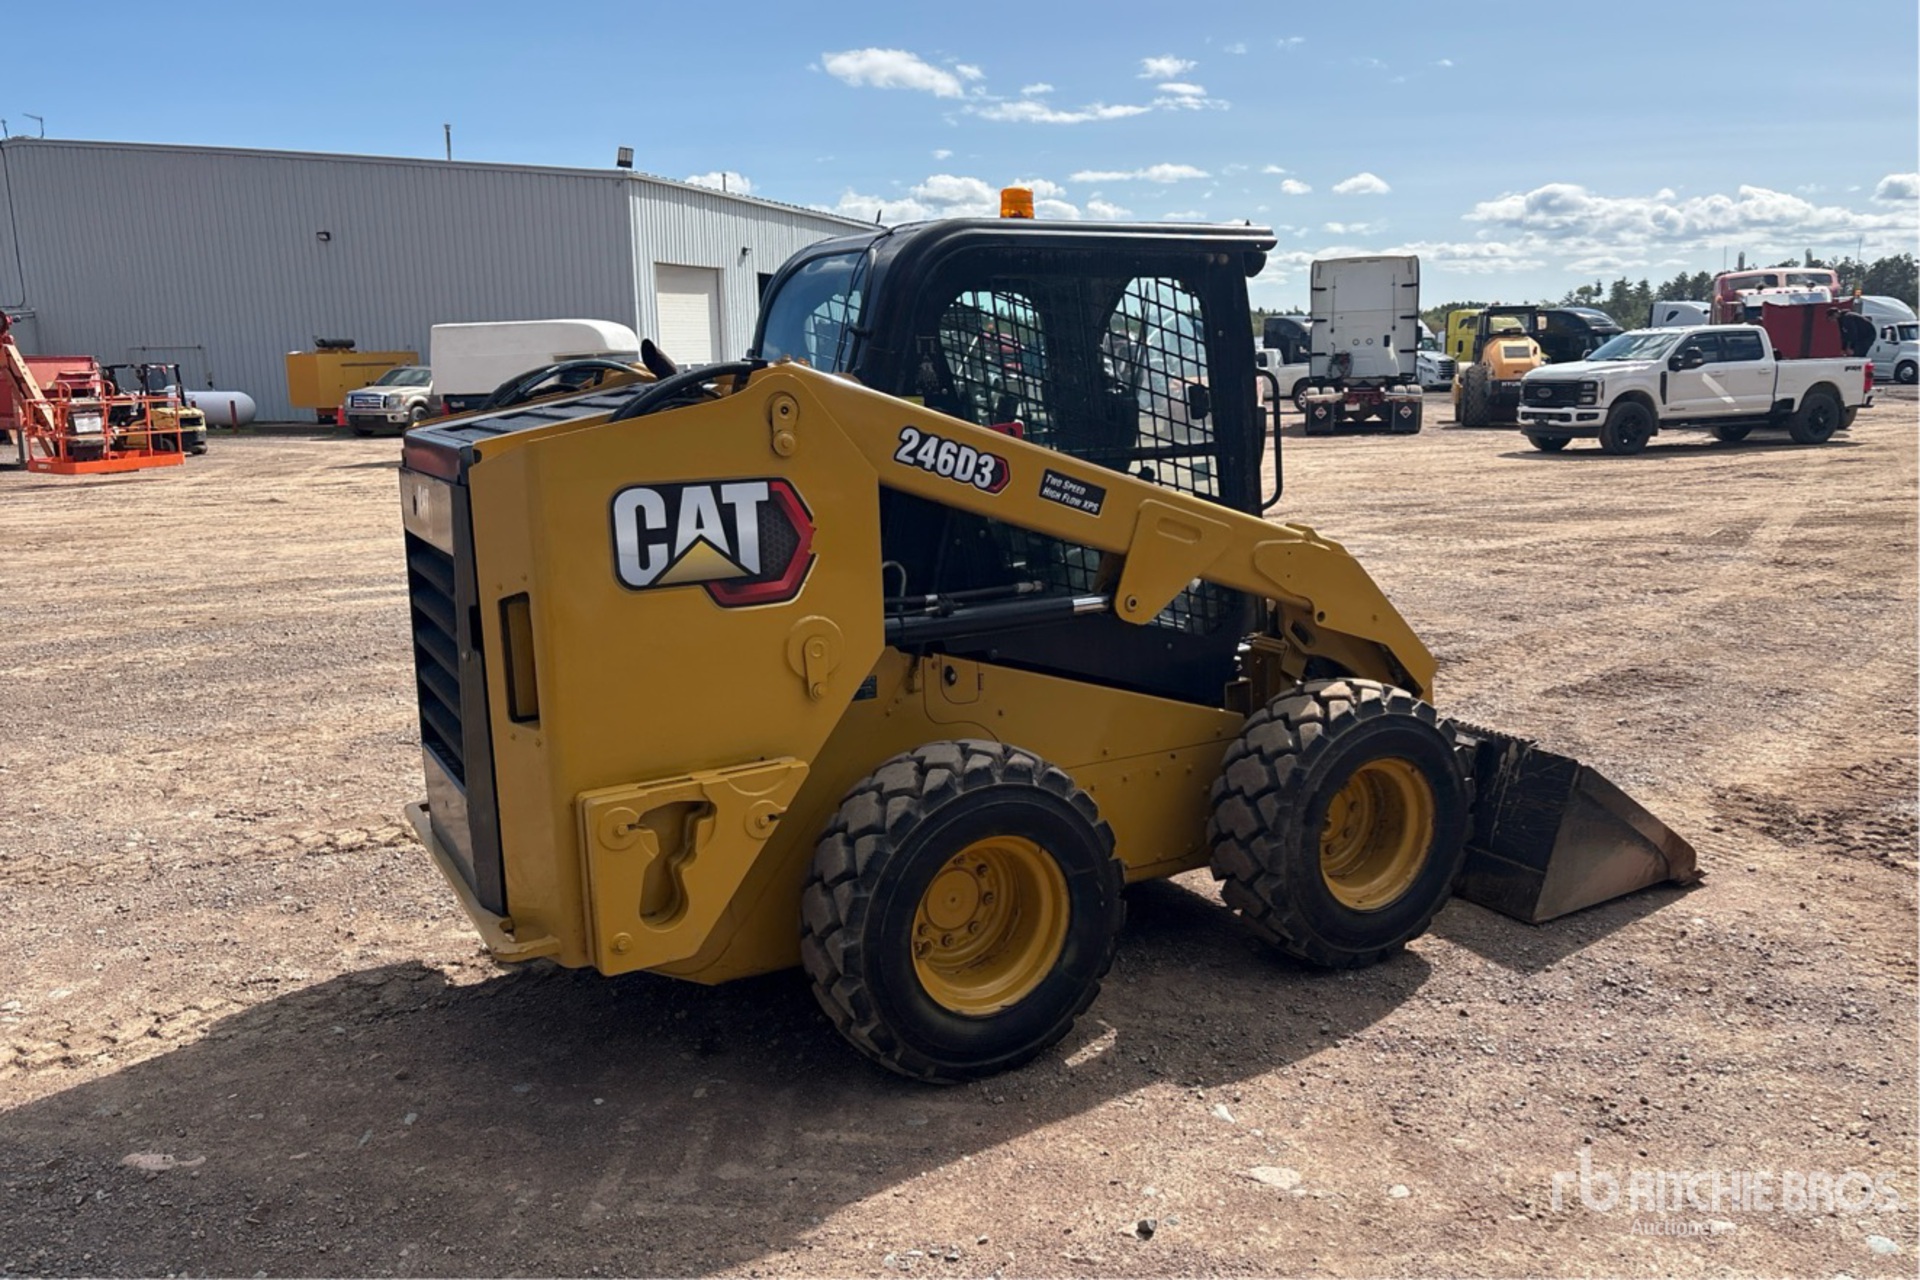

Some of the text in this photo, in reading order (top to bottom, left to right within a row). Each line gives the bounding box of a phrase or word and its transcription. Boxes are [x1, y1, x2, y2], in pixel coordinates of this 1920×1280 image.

[896, 428, 995, 488] 246D3
[614, 481, 769, 586] CAT
[1083, 501, 1099, 512] XPS
